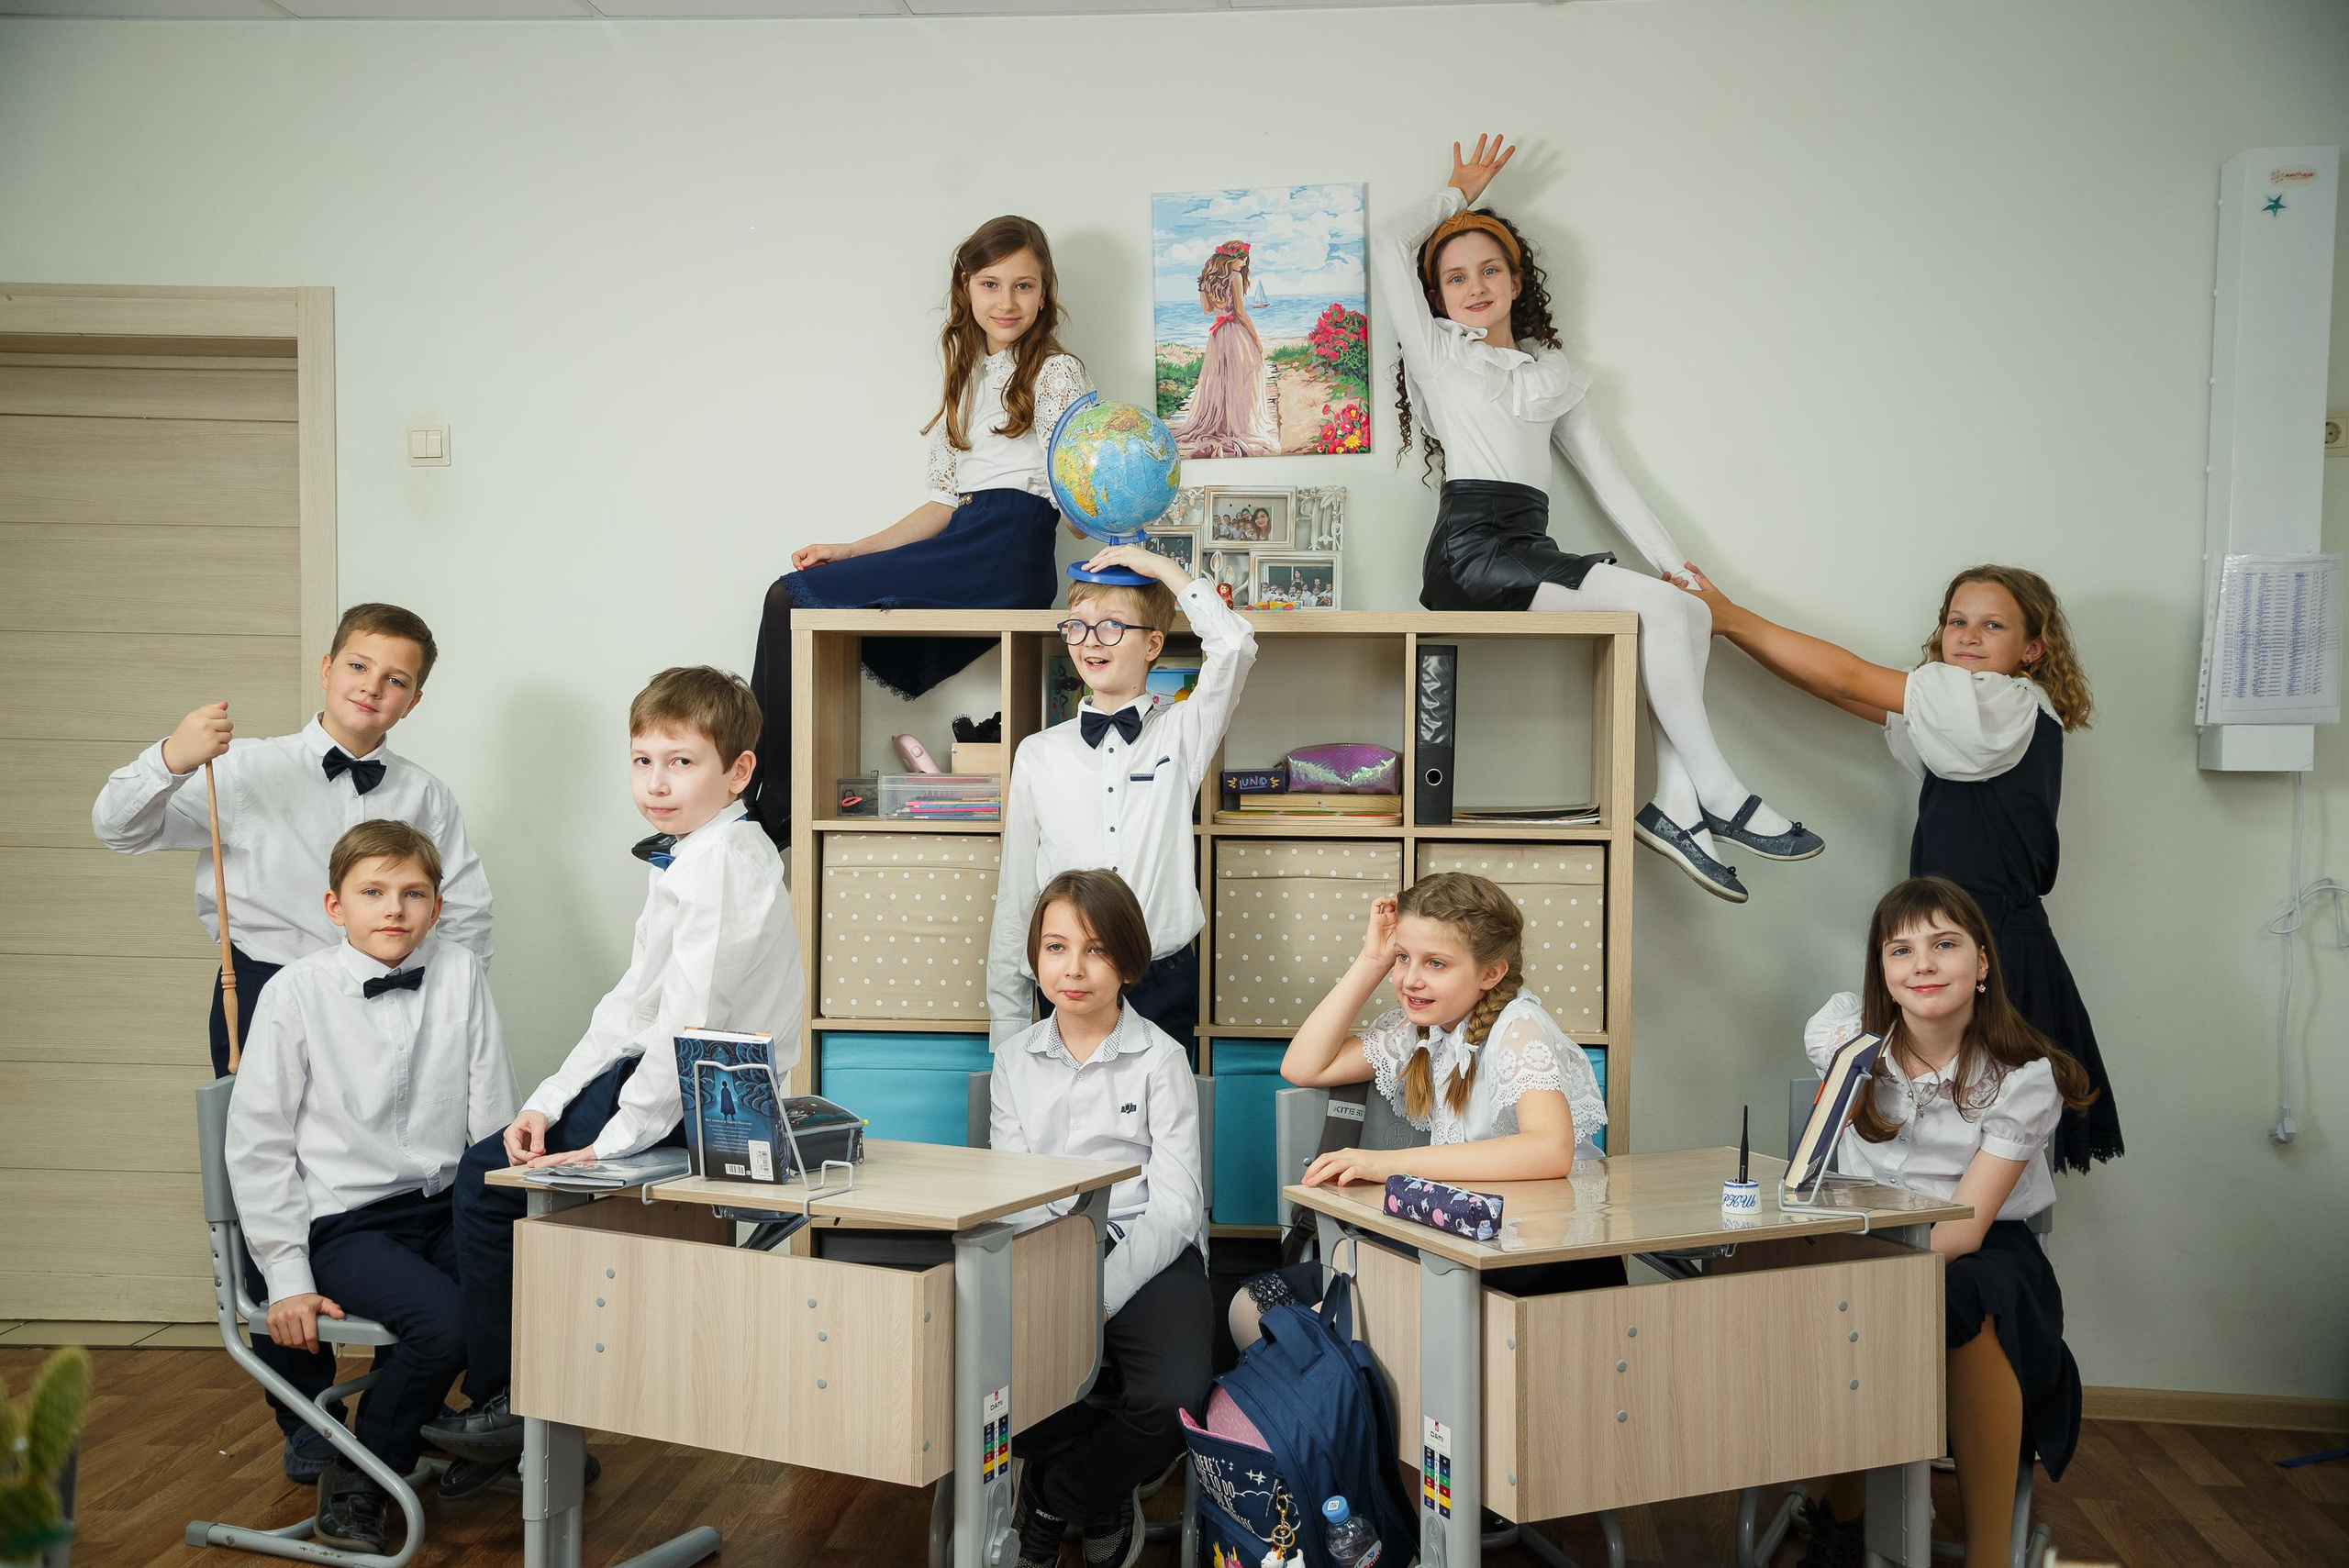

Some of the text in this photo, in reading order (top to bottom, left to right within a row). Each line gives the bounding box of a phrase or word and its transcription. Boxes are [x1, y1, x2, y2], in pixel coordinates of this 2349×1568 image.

[1241, 775, 1268, 787] UNO
[1333, 1105, 1355, 1116] KITE
[1430, 1430, 1444, 1443] DAMI
[1208, 1473, 1221, 1492] TO
[1221, 1479, 1235, 1498] DO
